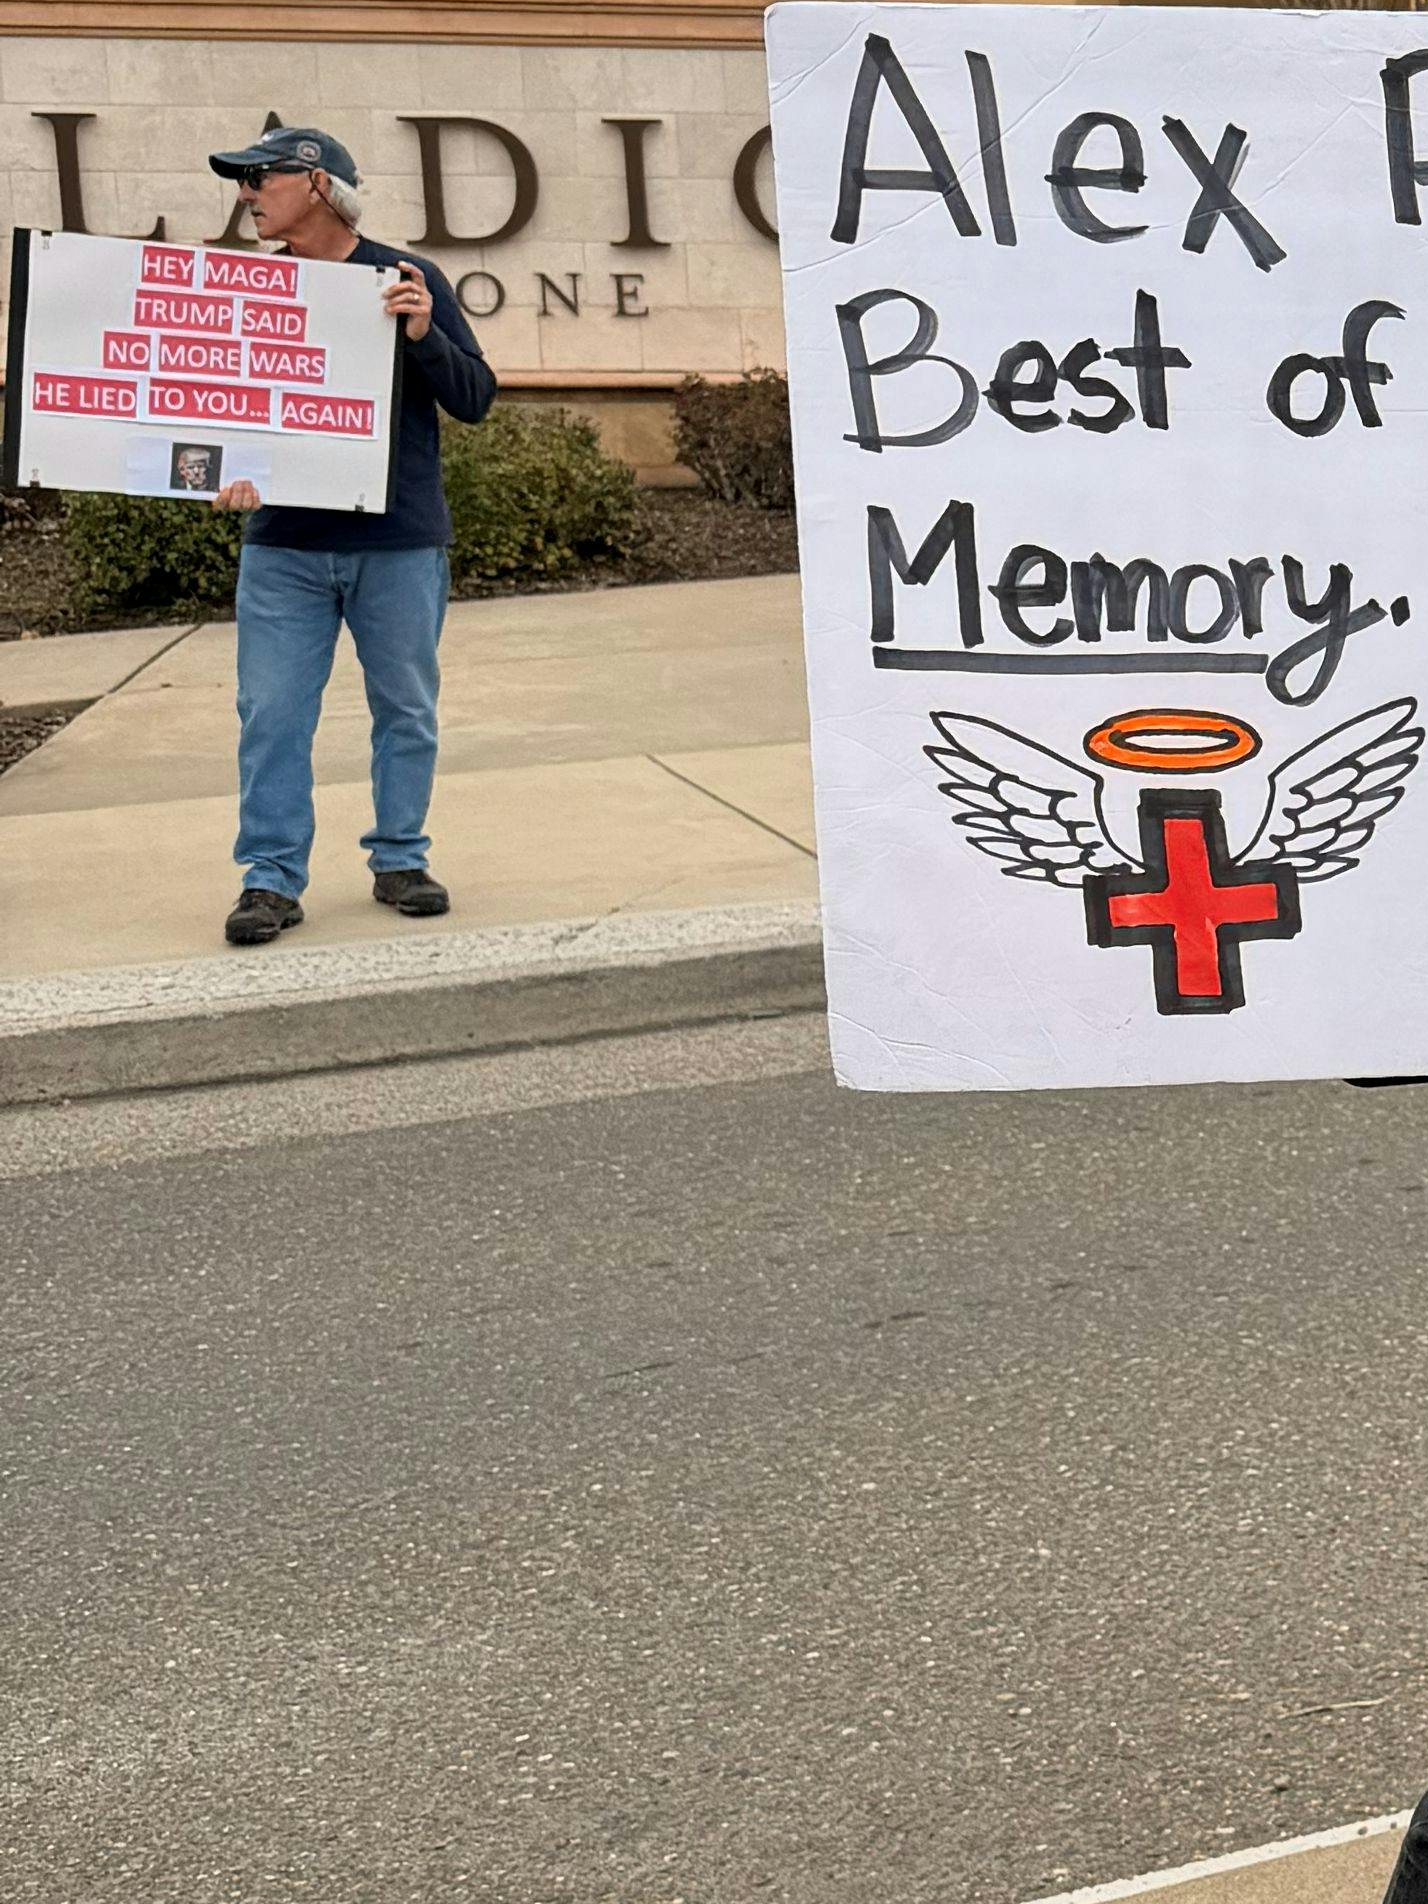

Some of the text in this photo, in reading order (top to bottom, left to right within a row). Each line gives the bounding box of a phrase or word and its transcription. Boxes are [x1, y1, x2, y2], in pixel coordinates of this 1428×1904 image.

[830, 33, 1287, 272] Alex
[143, 252, 298, 293] HEY MAGA!
[136, 296, 302, 336] TRUMP SAID
[108, 340, 326, 379] NO MORE WARS
[835, 288, 1192, 453] Best
[1267, 299, 1406, 437] of
[34, 382, 373, 430] HE LIED TO YOU... AGAIN!
[866, 500, 1411, 707] Memory.
